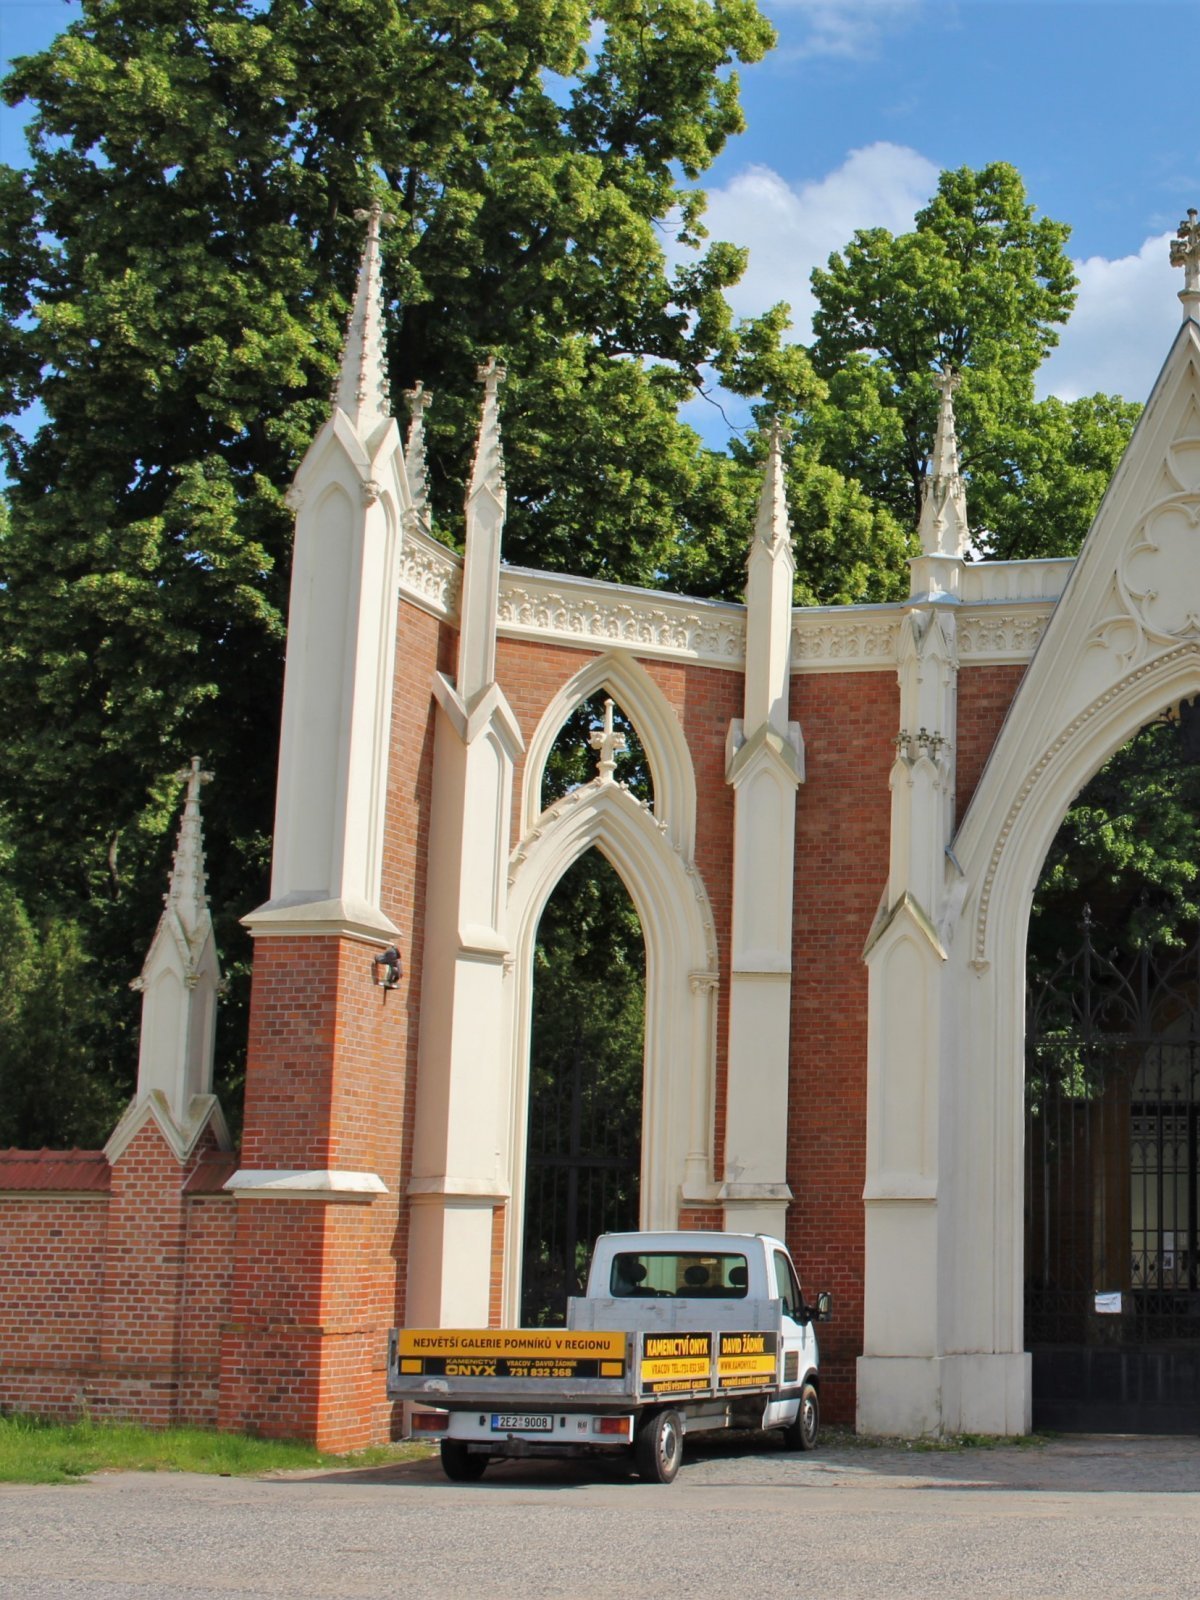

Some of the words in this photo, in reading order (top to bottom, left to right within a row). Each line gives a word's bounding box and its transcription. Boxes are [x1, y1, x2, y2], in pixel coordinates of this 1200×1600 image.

[413, 1336, 458, 1348] NEJVĚTŠÍ
[461, 1338, 502, 1348] GALERIE
[504, 1336, 552, 1349] POMNÍKŮ
[555, 1340, 563, 1349] V
[564, 1340, 611, 1350] REGIONU
[647, 1335, 689, 1356] KAMENICTVÍ
[689, 1338, 708, 1355] ONYX
[722, 1337, 742, 1354] DAVID
[445, 1365, 496, 1376] ONYX
[509, 1368, 528, 1377] 731
[530, 1368, 551, 1377] 832
[552, 1368, 572, 1377] 368
[500, 1417, 518, 1428] 2E2
[524, 1417, 547, 1428] 9008
